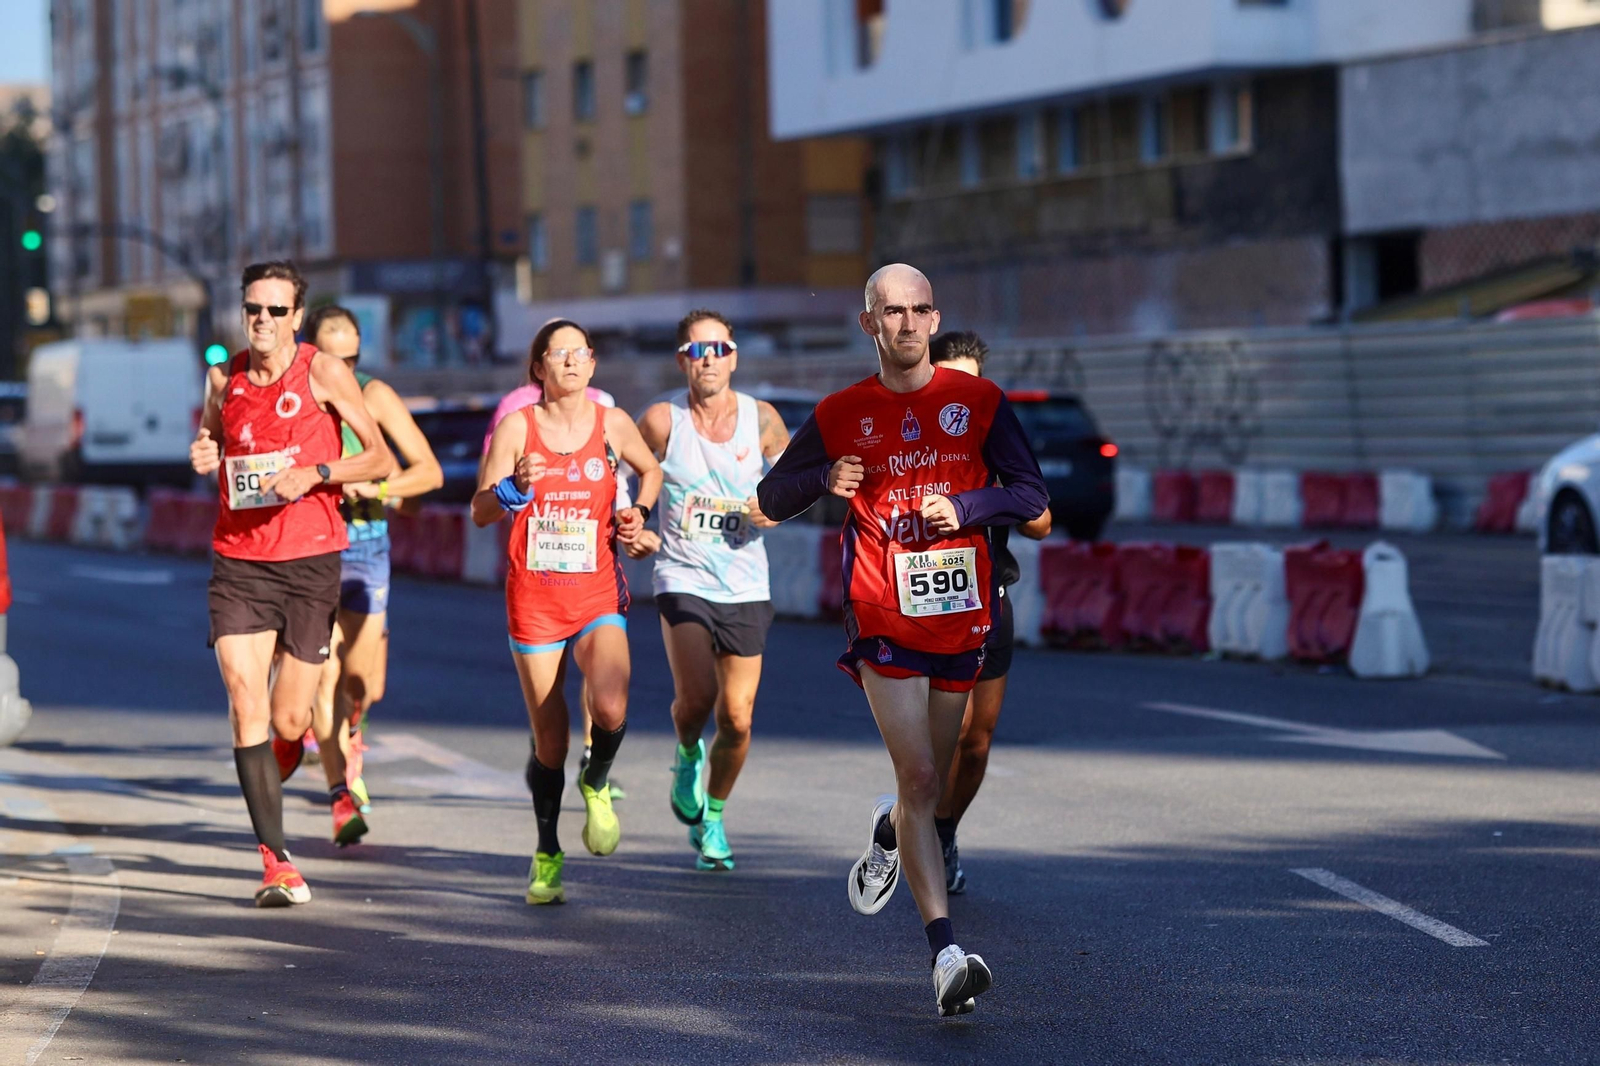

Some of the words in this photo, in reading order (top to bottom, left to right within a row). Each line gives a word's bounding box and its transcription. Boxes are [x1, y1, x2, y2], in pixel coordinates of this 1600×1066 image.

[236, 471, 276, 492] 60
[888, 481, 951, 502] ATLETISMO
[543, 490, 591, 501] ATLETISMO
[694, 512, 740, 532] 100
[872, 504, 938, 543] Véle
[538, 541, 586, 551] VELASCO
[922, 560, 938, 568] 10k
[942, 556, 964, 566] 2025
[540, 578, 580, 587] DENTAL
[910, 568, 968, 597] 590
